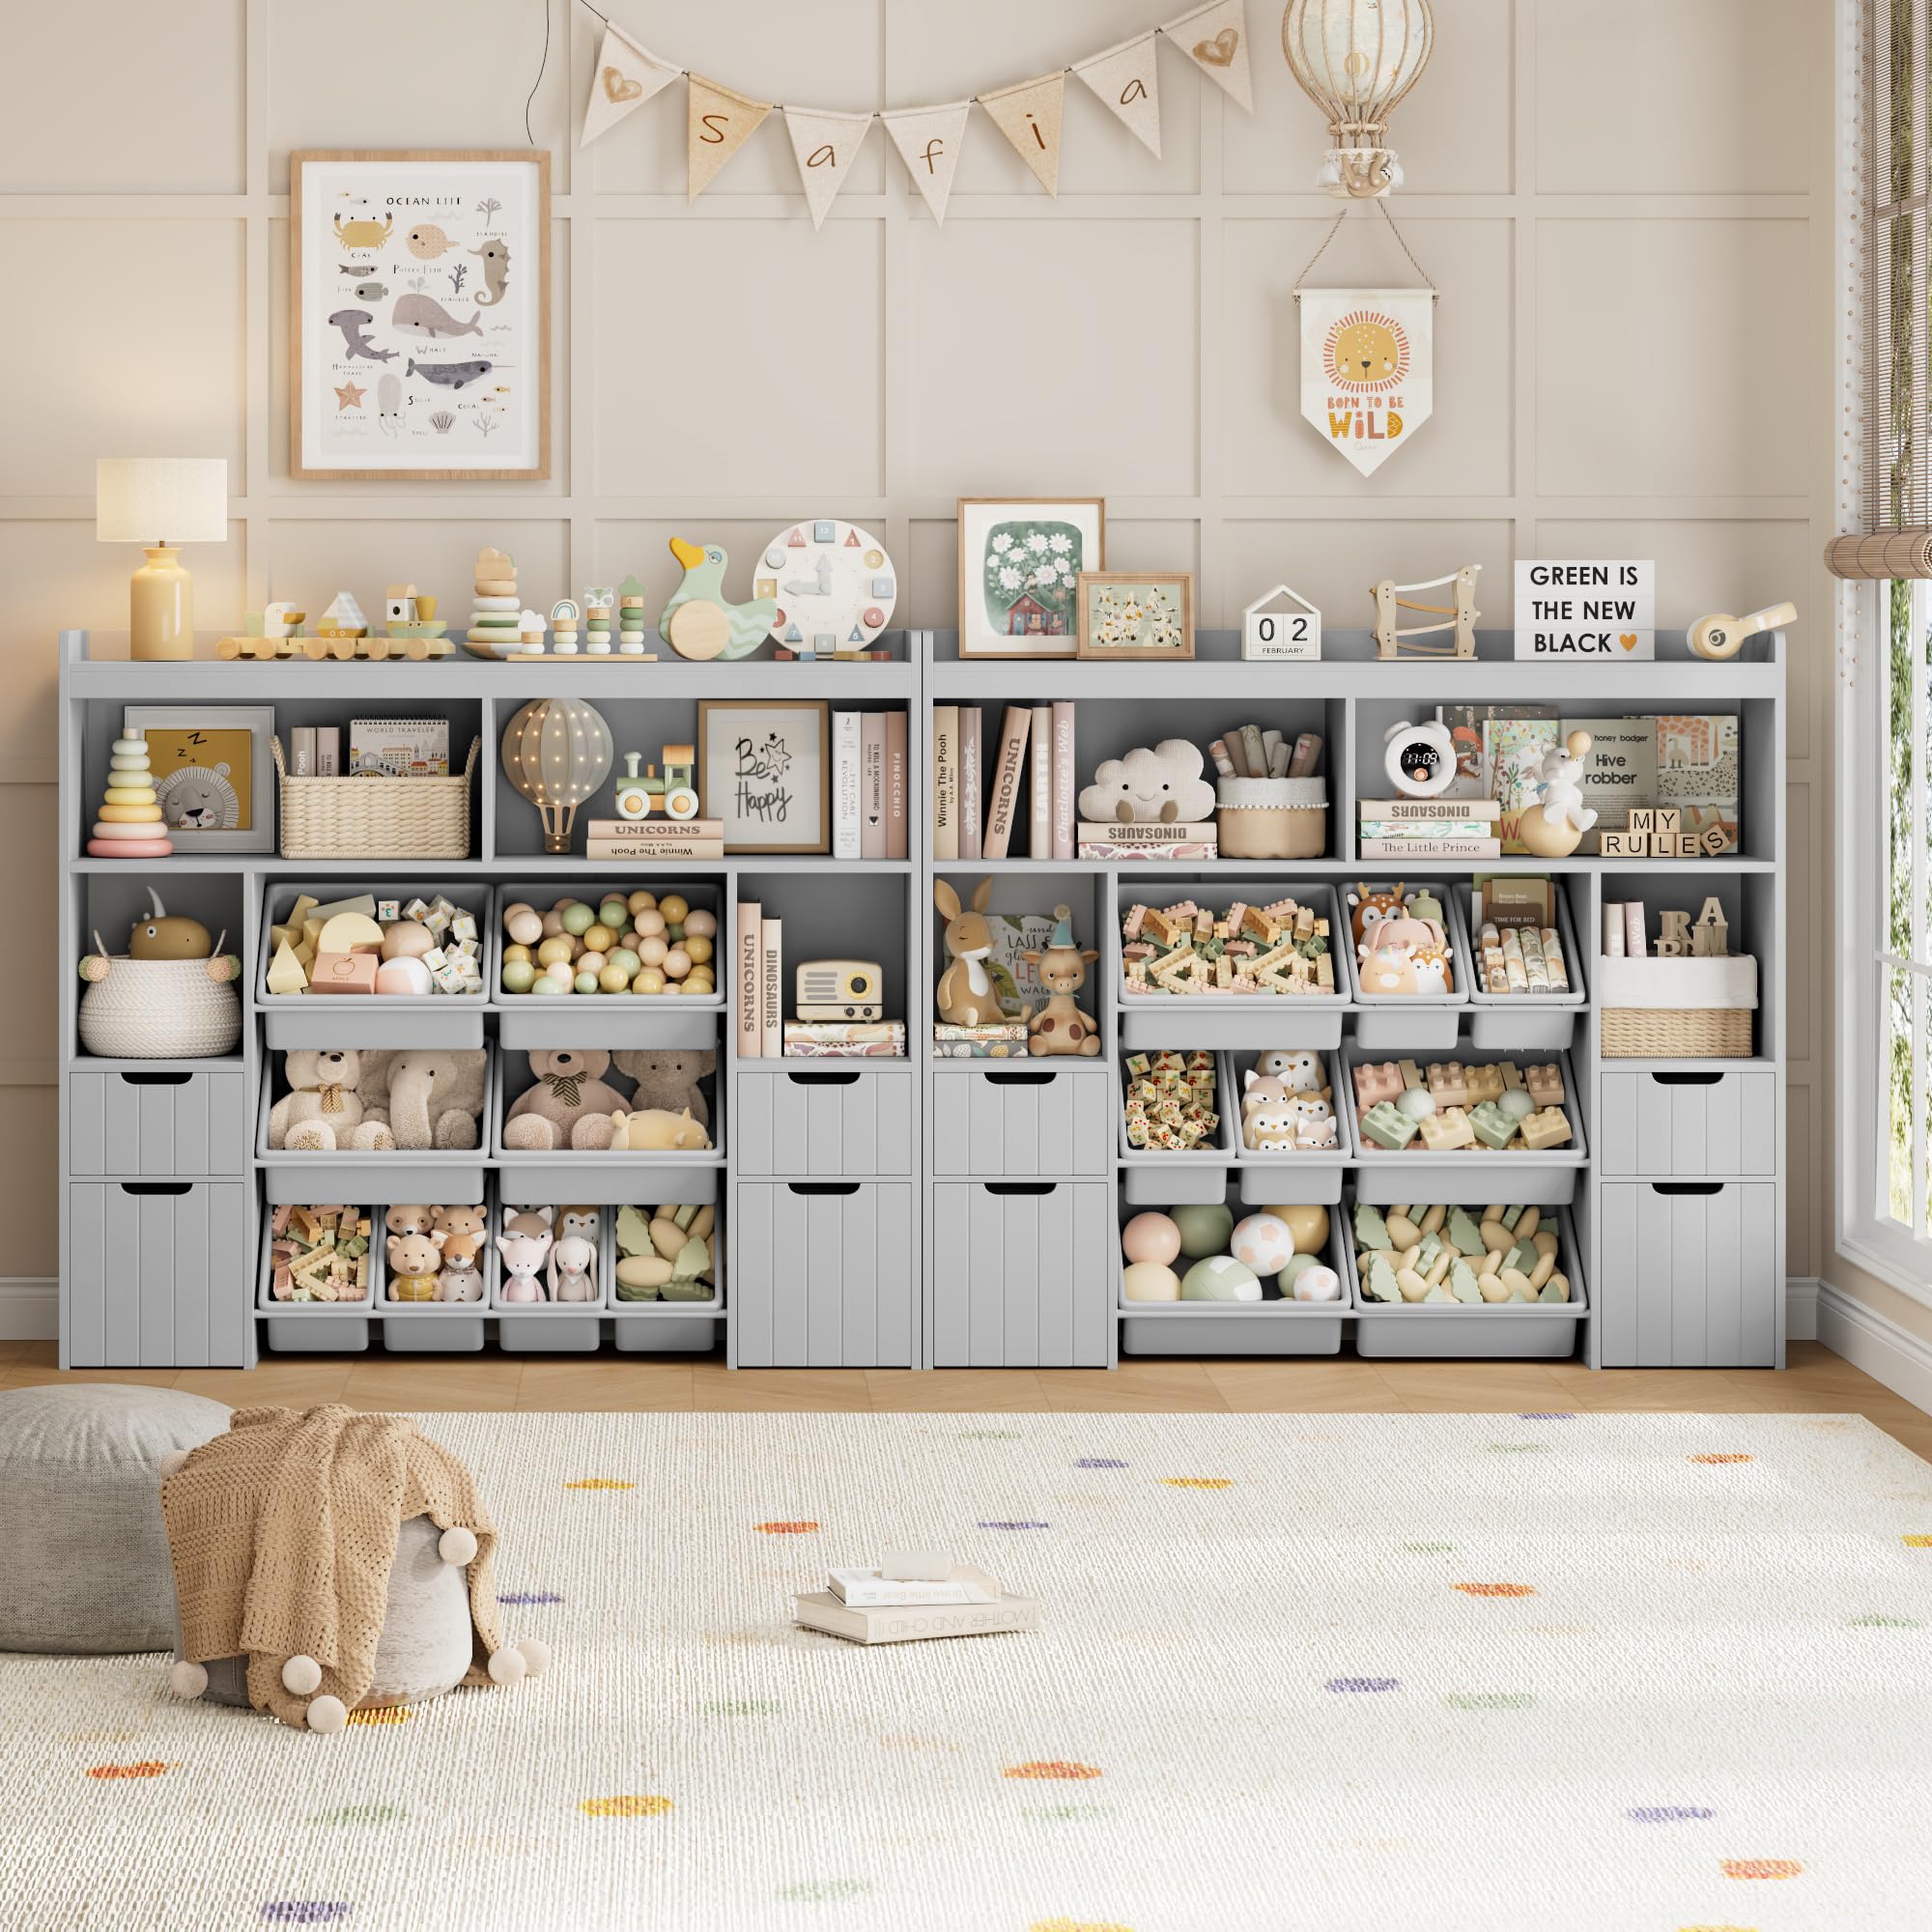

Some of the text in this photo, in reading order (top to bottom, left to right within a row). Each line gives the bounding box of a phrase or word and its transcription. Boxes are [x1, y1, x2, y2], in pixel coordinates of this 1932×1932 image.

[386, 197, 430, 206] OCEAN
[1327, 396, 1405, 410] BORN TO BE
[1530, 566, 1638, 585] GREEN IS
[1532, 601, 1635, 620] THE NEW
[1534, 633, 1612, 653] BLACK
[1058, 720, 1069, 753] Web
[298, 750, 307, 776] Pooh
[735, 737, 770, 780] Be
[1596, 754, 1626, 767] Hive
[938, 734, 947, 828] Winnie The Pooh
[994, 738, 1020, 835] UNICORNS
[1585, 772, 1637, 784] robber
[734, 781, 793, 822] Happy
[1391, 806, 1470, 817] DINOSAURS
[614, 826, 700, 835] UNICORNS
[1108, 827, 1186, 839] DINOSAURS
[1382, 842, 1480, 852] The Little Prince
[744, 934, 754, 1033] UNICORNS
[766, 950, 778, 1029] DINOSAURS
